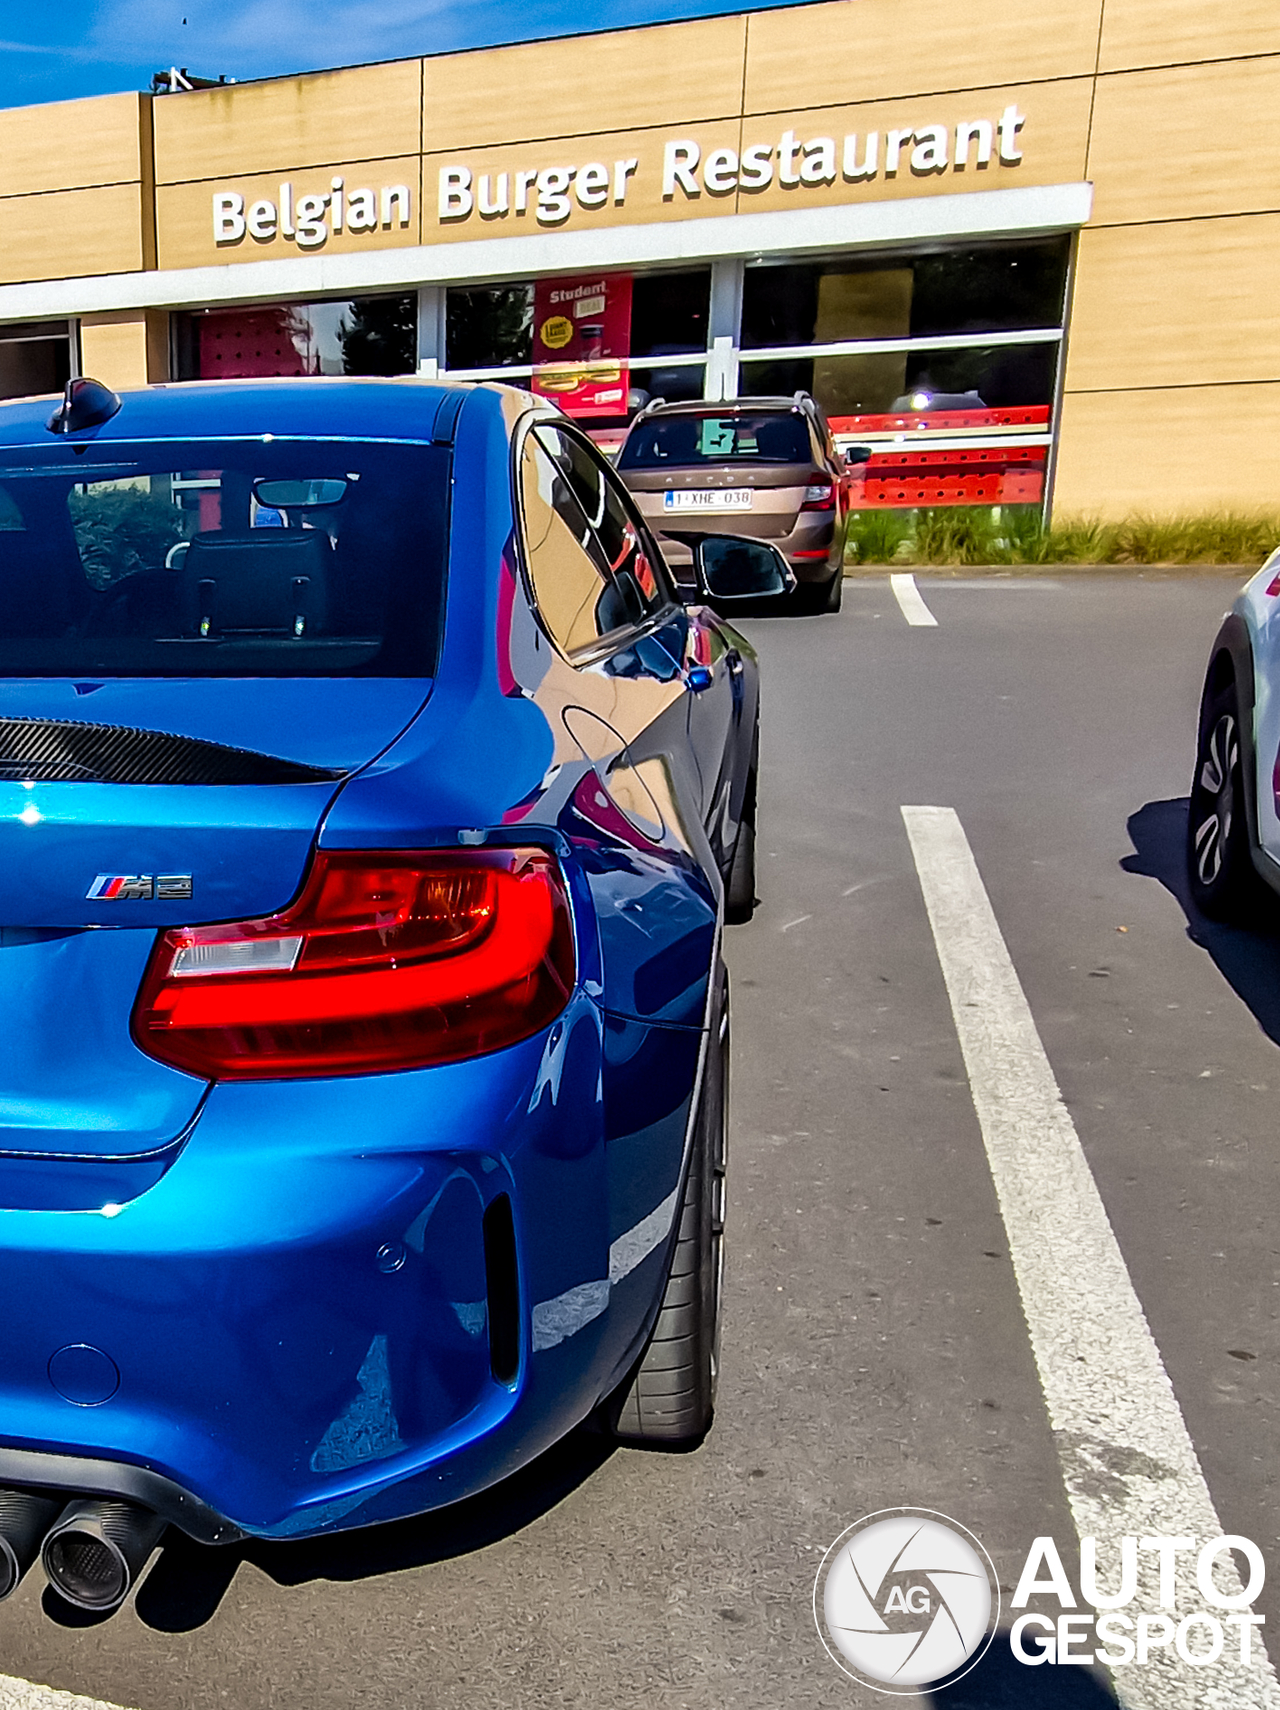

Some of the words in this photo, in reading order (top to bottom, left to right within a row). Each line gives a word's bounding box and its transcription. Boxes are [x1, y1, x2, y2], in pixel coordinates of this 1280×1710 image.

[213, 176, 410, 250] Belgian
[438, 156, 638, 225] Burger
[662, 103, 1026, 201] Restaurant
[549, 280, 607, 303] Student
